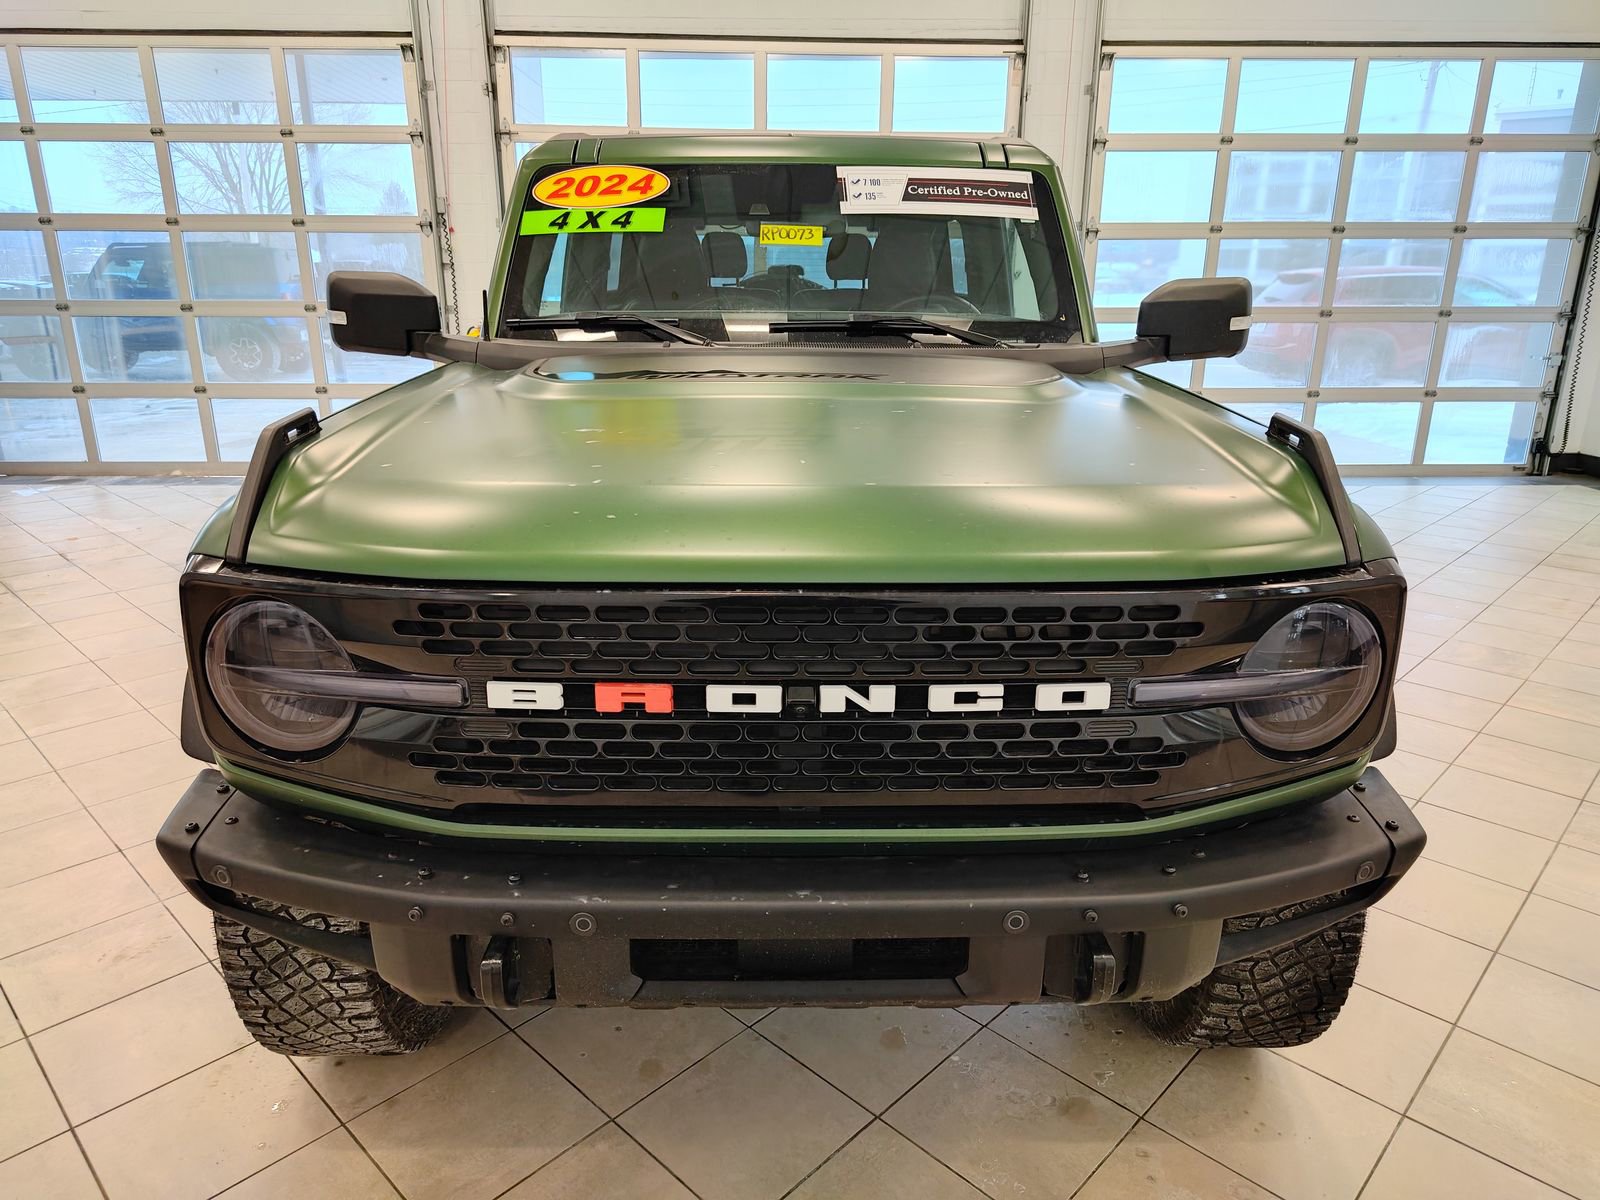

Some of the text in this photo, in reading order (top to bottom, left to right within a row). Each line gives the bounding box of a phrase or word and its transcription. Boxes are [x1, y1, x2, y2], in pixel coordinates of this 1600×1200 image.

[546, 173, 656, 199] 2024
[907, 185, 1029, 200] Certified Pre-Owned
[864, 192, 877, 201] 135
[486, 680, 1111, 713] BRONCO
